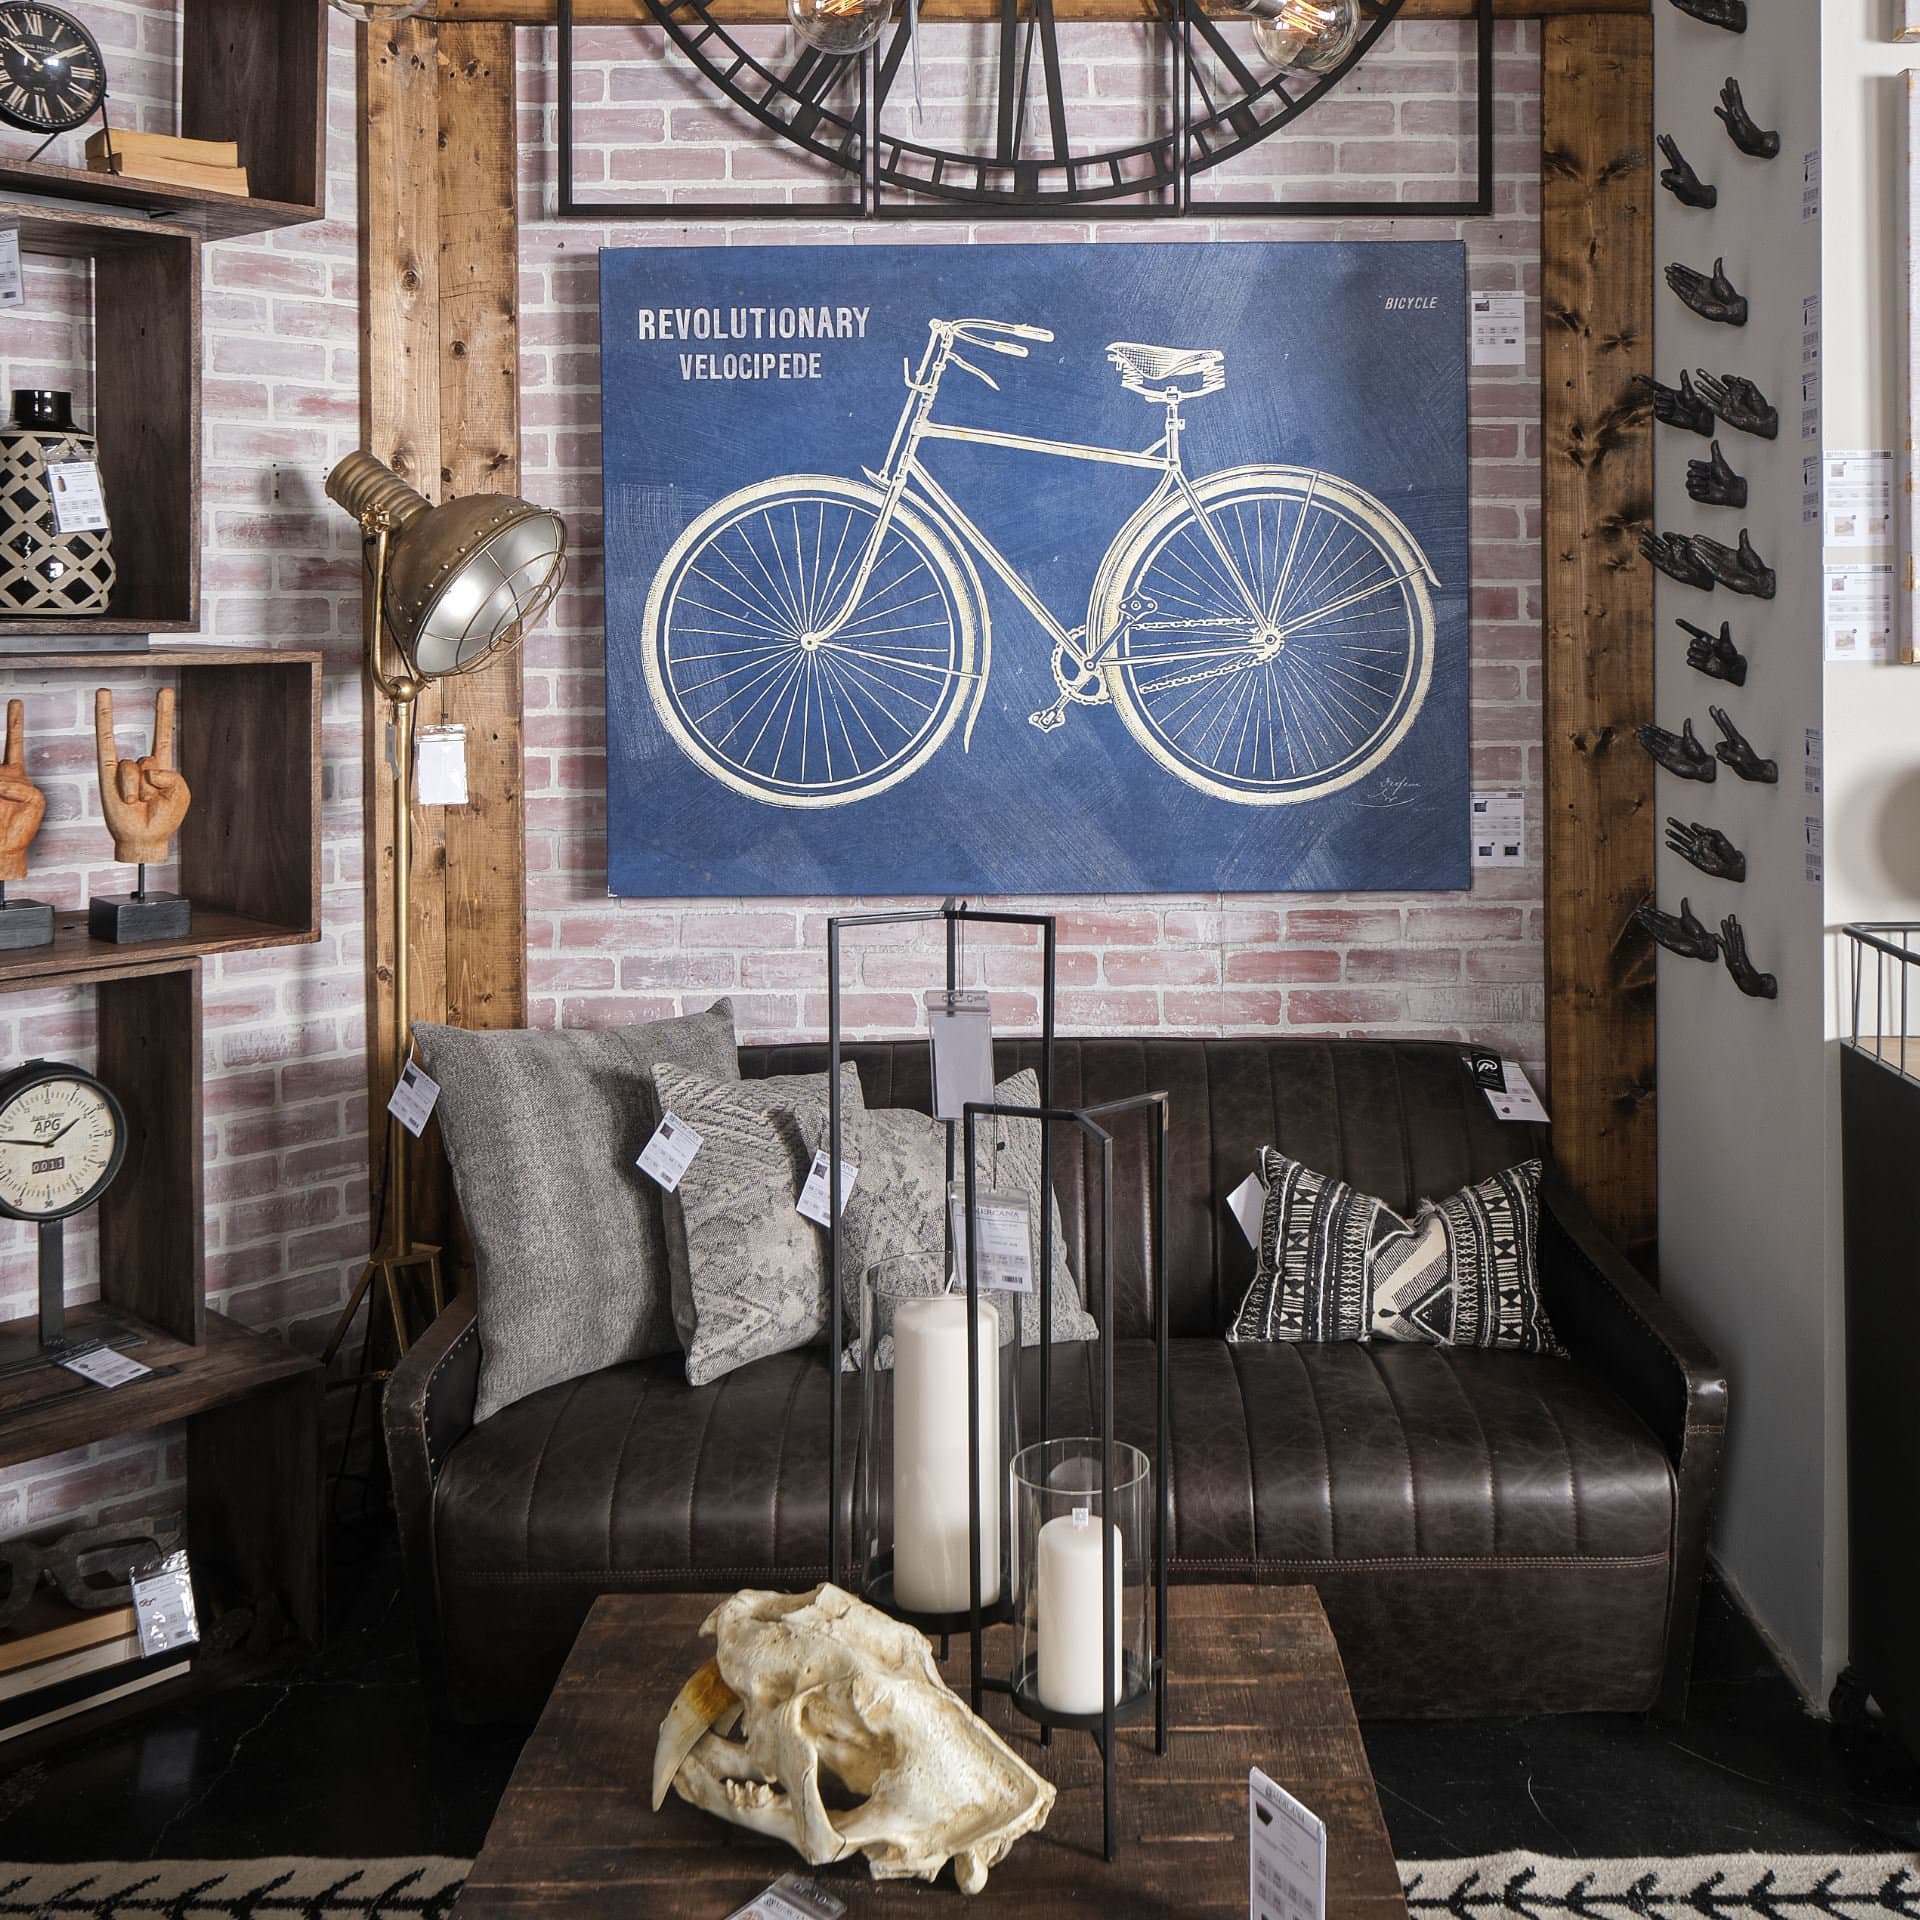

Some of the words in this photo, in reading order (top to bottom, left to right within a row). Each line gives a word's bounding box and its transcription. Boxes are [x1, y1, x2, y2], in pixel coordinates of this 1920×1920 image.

[1384, 296, 1439, 310] BICYCLE
[639, 306, 871, 340] REVOLUTIONARY
[679, 352, 823, 381] VELOCIPEDE
[96, 1103, 105, 1111] 10
[33, 1118, 61, 1134] APG
[103, 1129, 113, 1138] 15
